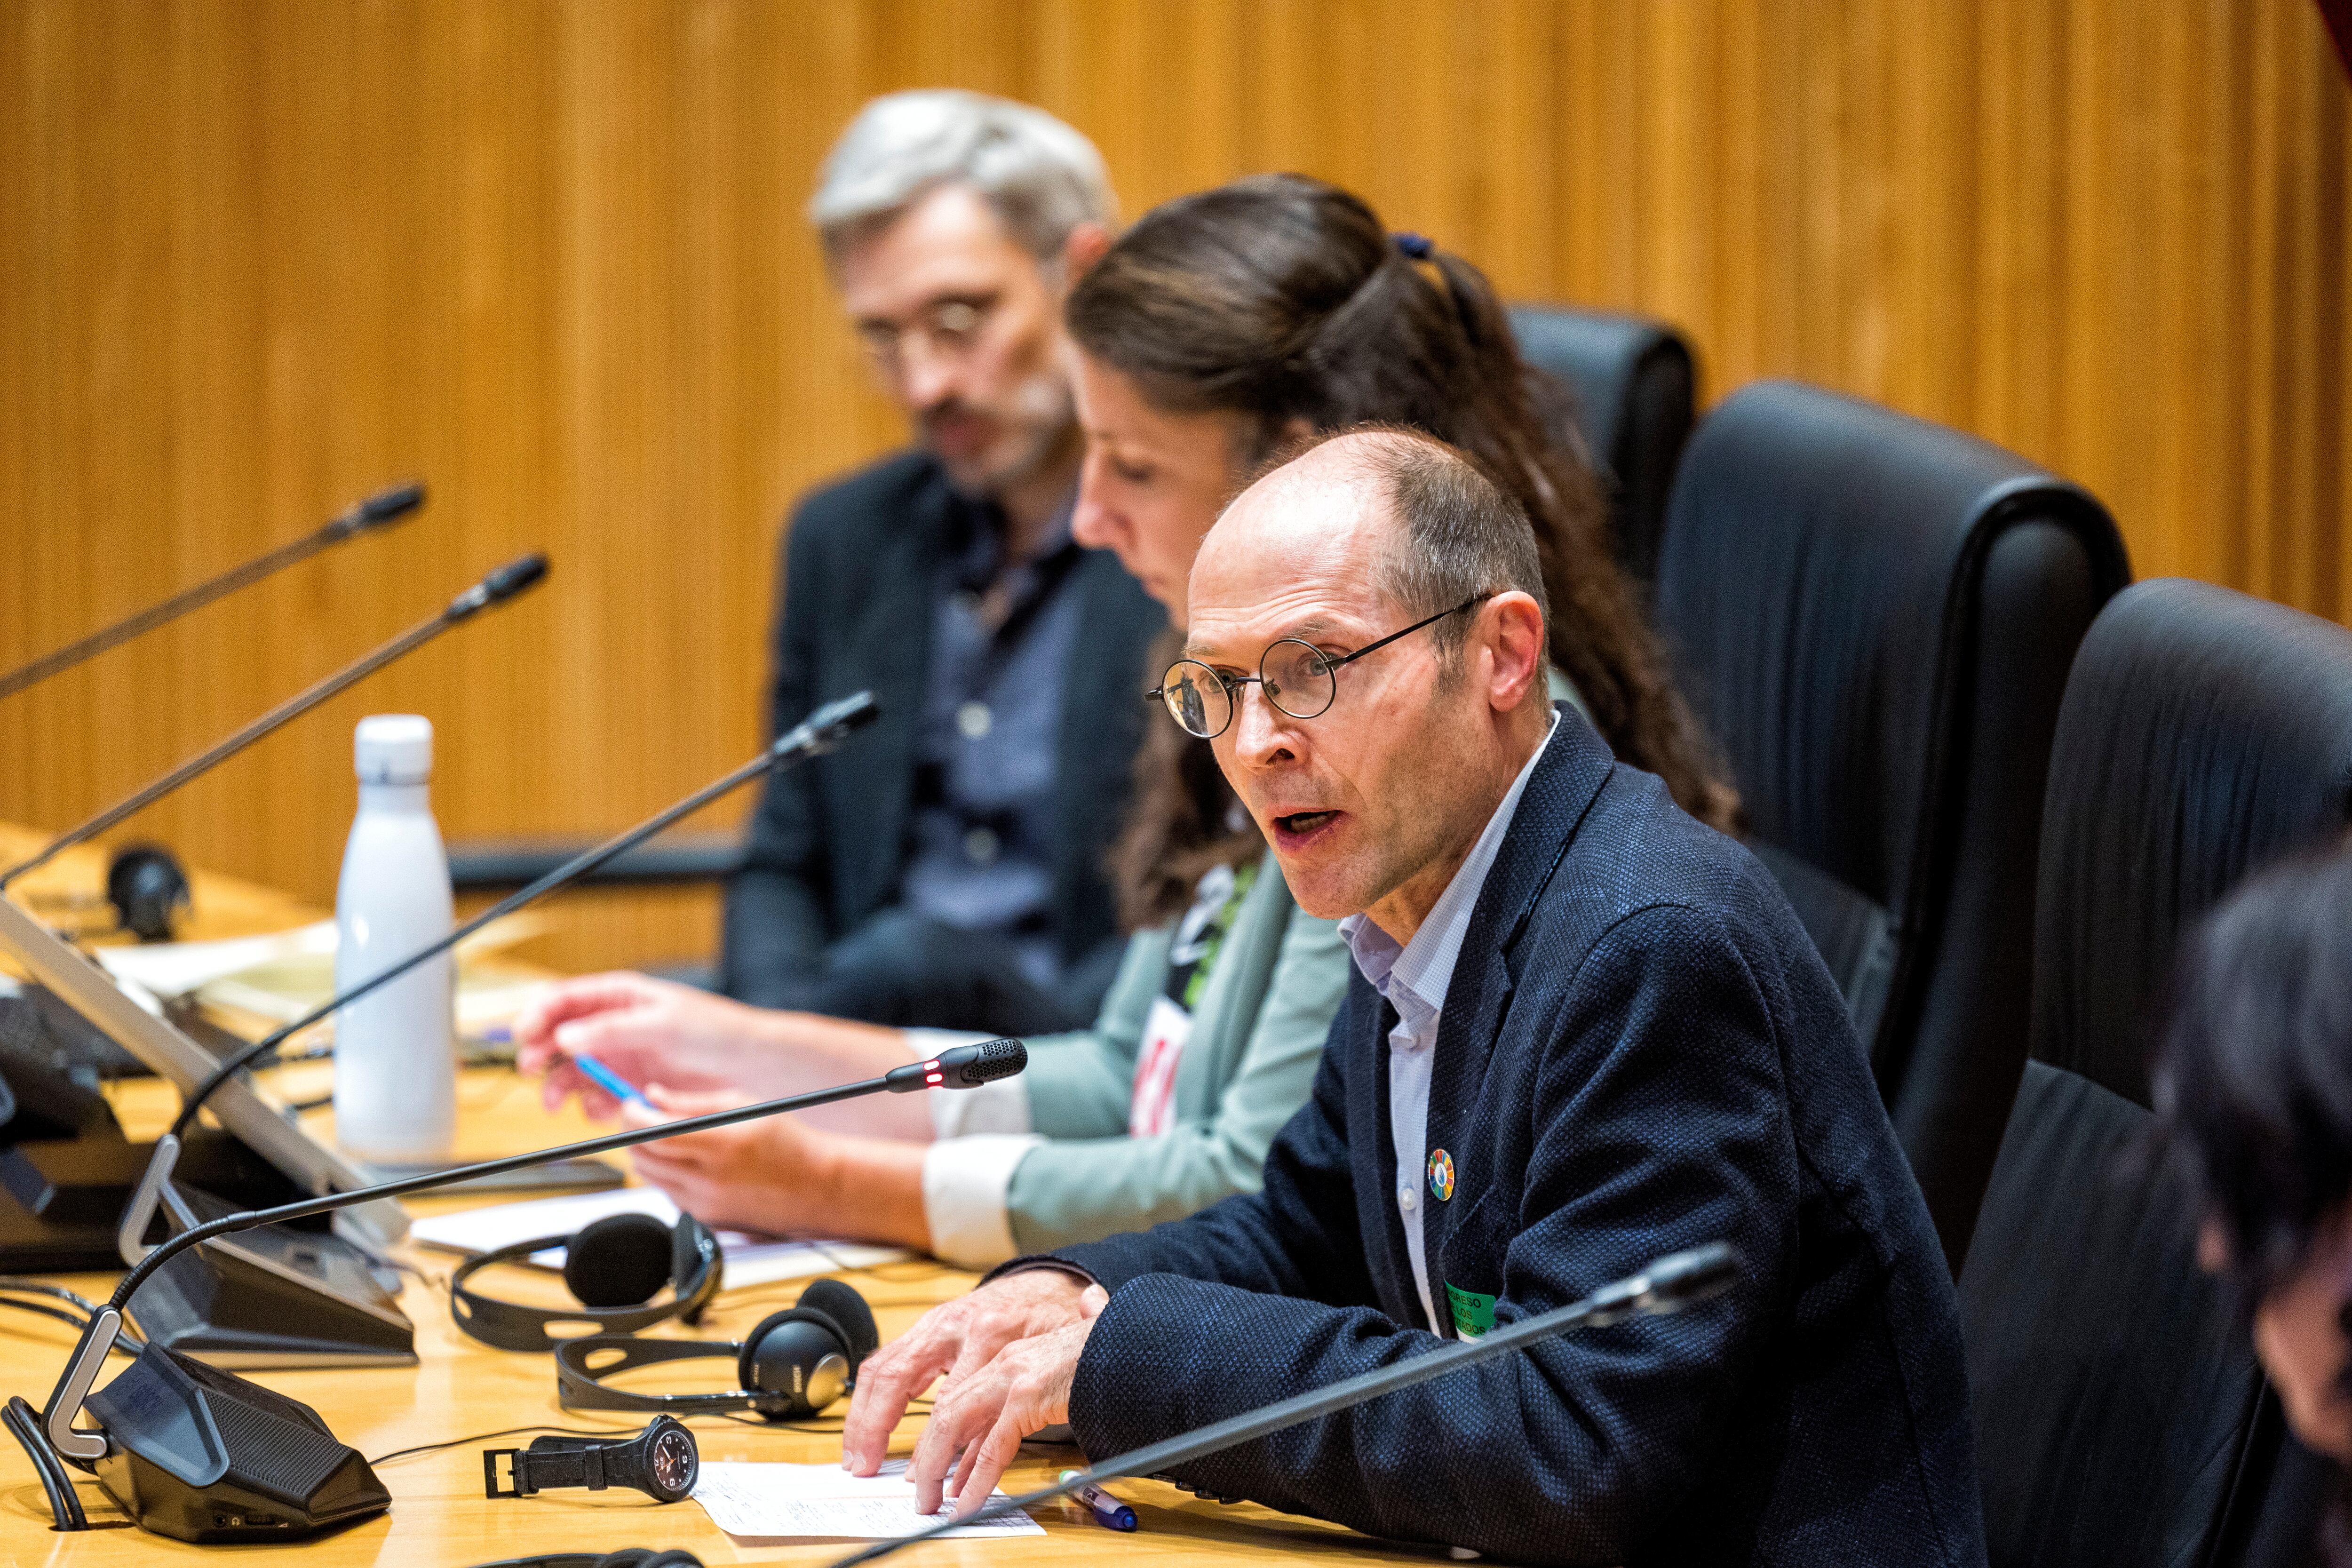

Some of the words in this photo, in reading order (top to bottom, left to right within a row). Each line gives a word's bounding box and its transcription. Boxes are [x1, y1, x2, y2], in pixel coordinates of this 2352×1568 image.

[1448, 1290, 1481, 1308] NGRESO
[1457, 1305, 1473, 1320] LOS
[1455, 1317, 1486, 1335] TADOS
[666, 1436, 672, 1444] 3
[682, 1455, 688, 1464] 6
[669, 1478, 675, 1487] 9
